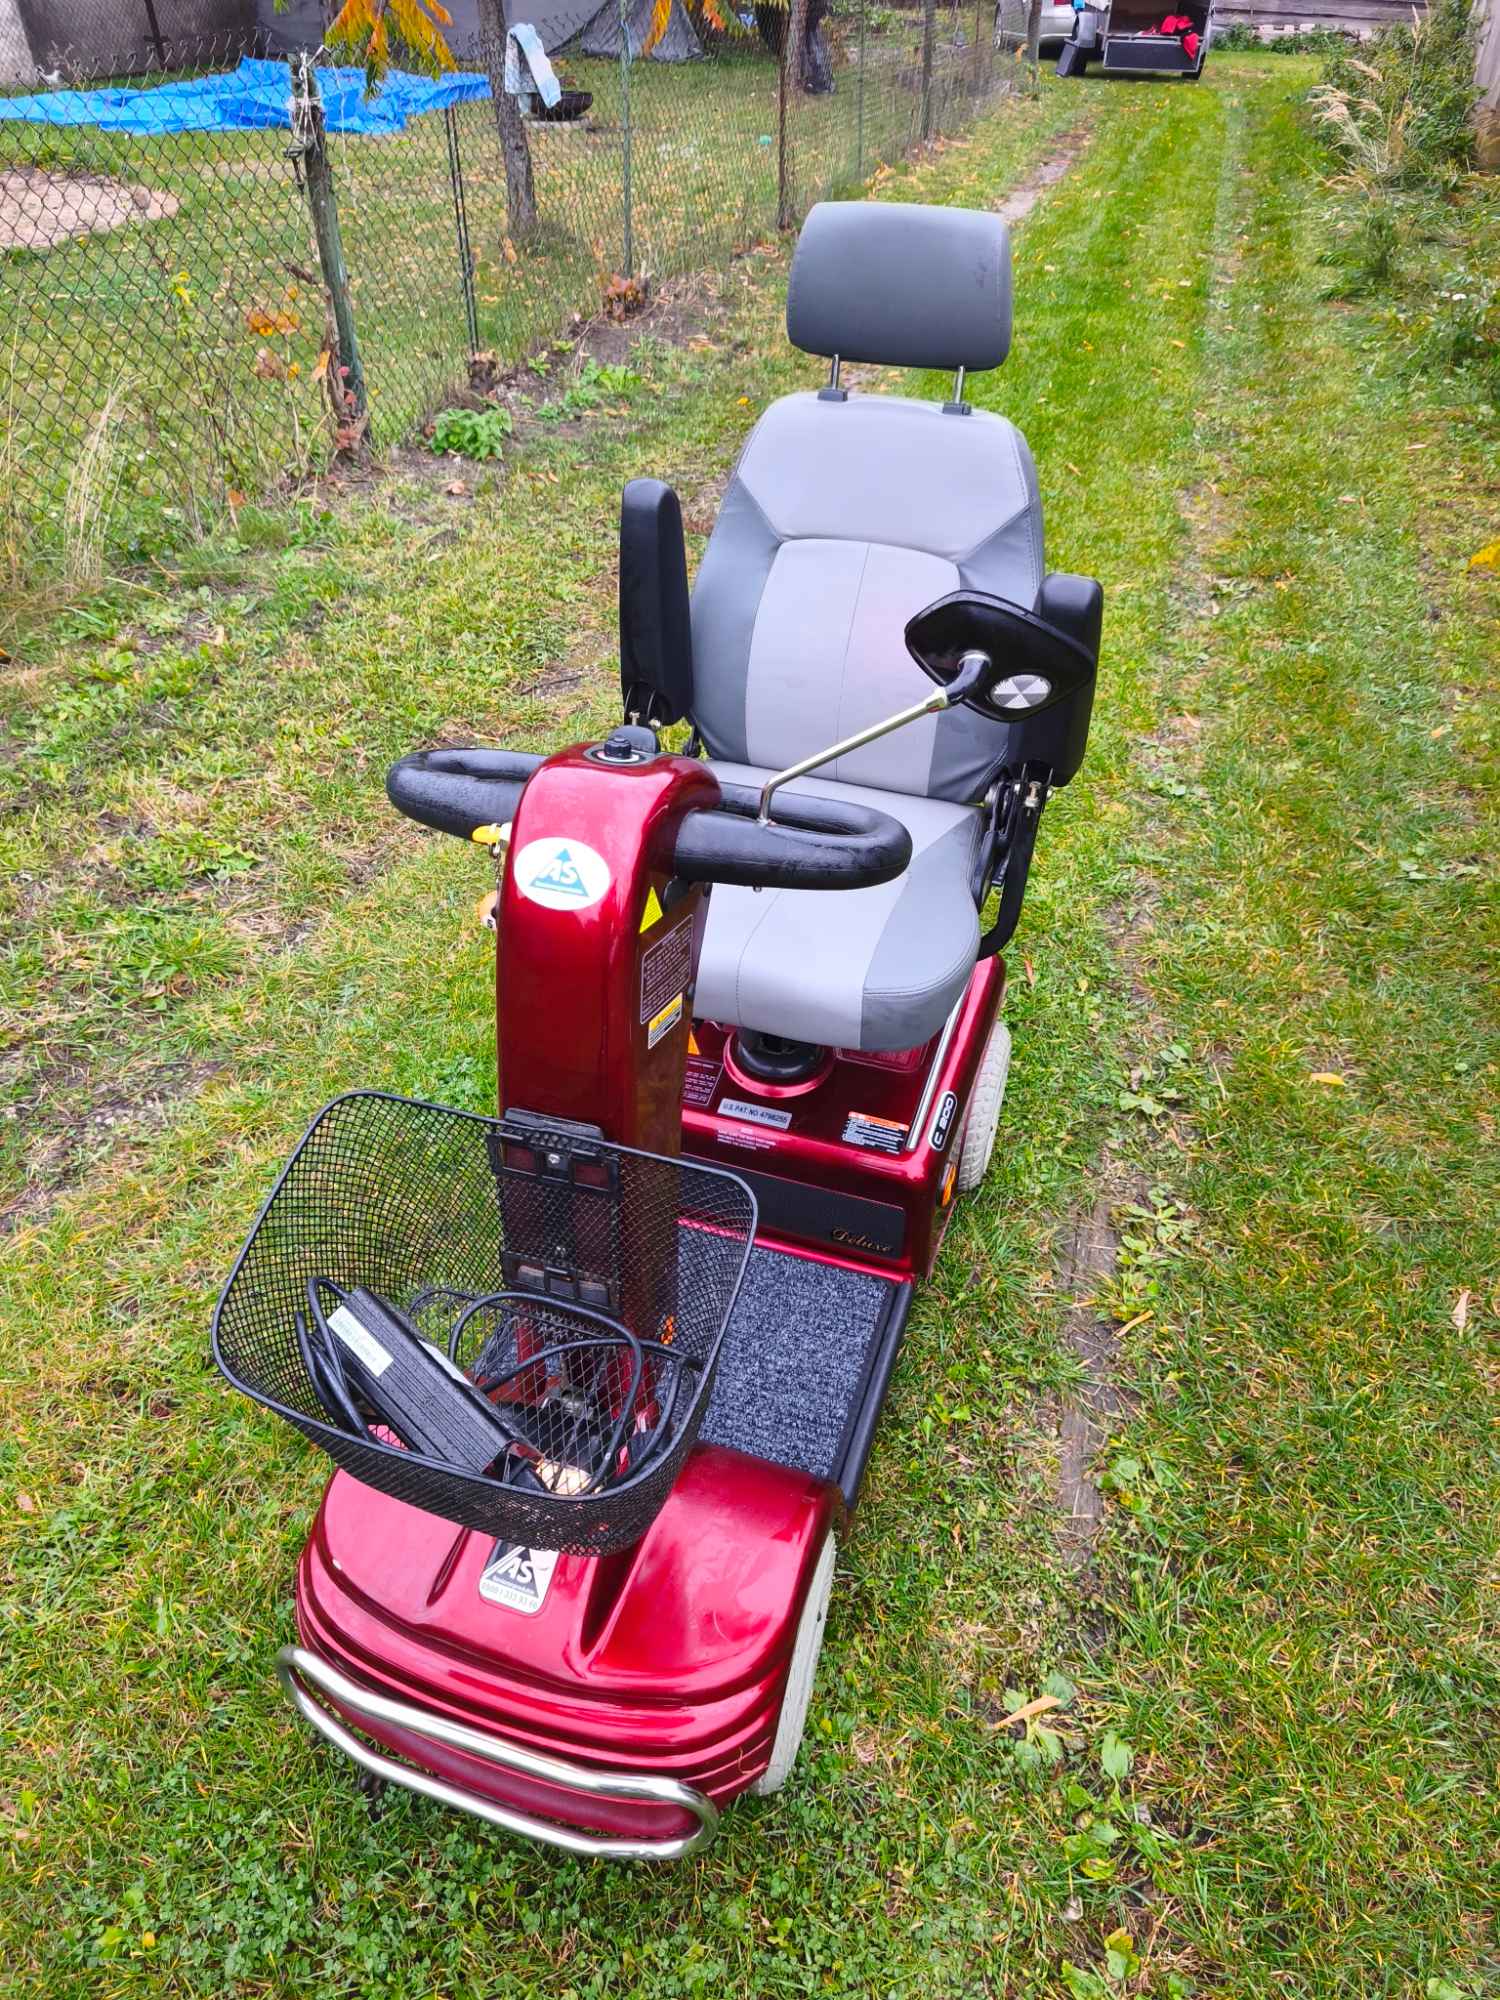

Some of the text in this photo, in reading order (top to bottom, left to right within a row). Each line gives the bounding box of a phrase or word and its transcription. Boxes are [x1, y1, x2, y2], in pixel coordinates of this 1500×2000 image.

[540, 860, 578, 885] AS
[832, 1227, 891, 1252] Deluxe
[496, 1556, 533, 1584] AS
